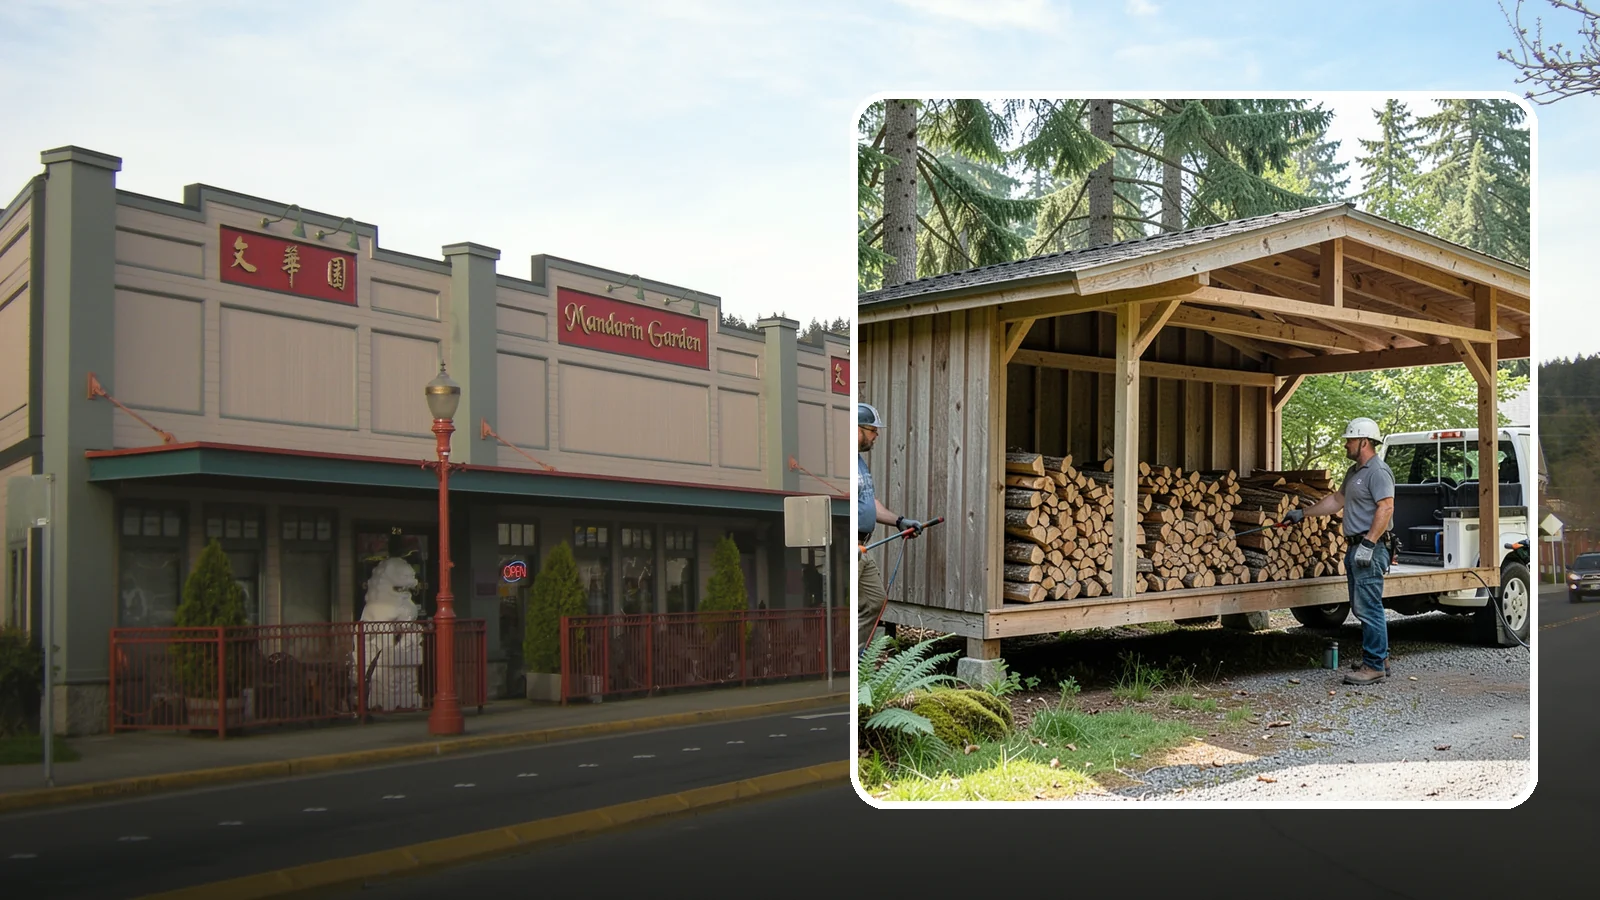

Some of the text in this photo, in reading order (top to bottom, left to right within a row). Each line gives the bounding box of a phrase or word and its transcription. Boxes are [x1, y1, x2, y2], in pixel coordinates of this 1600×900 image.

[231, 235, 346, 291] 文華園
[564, 302, 701, 353] Mandarin Garden
[503, 566, 526, 578] OPEN
